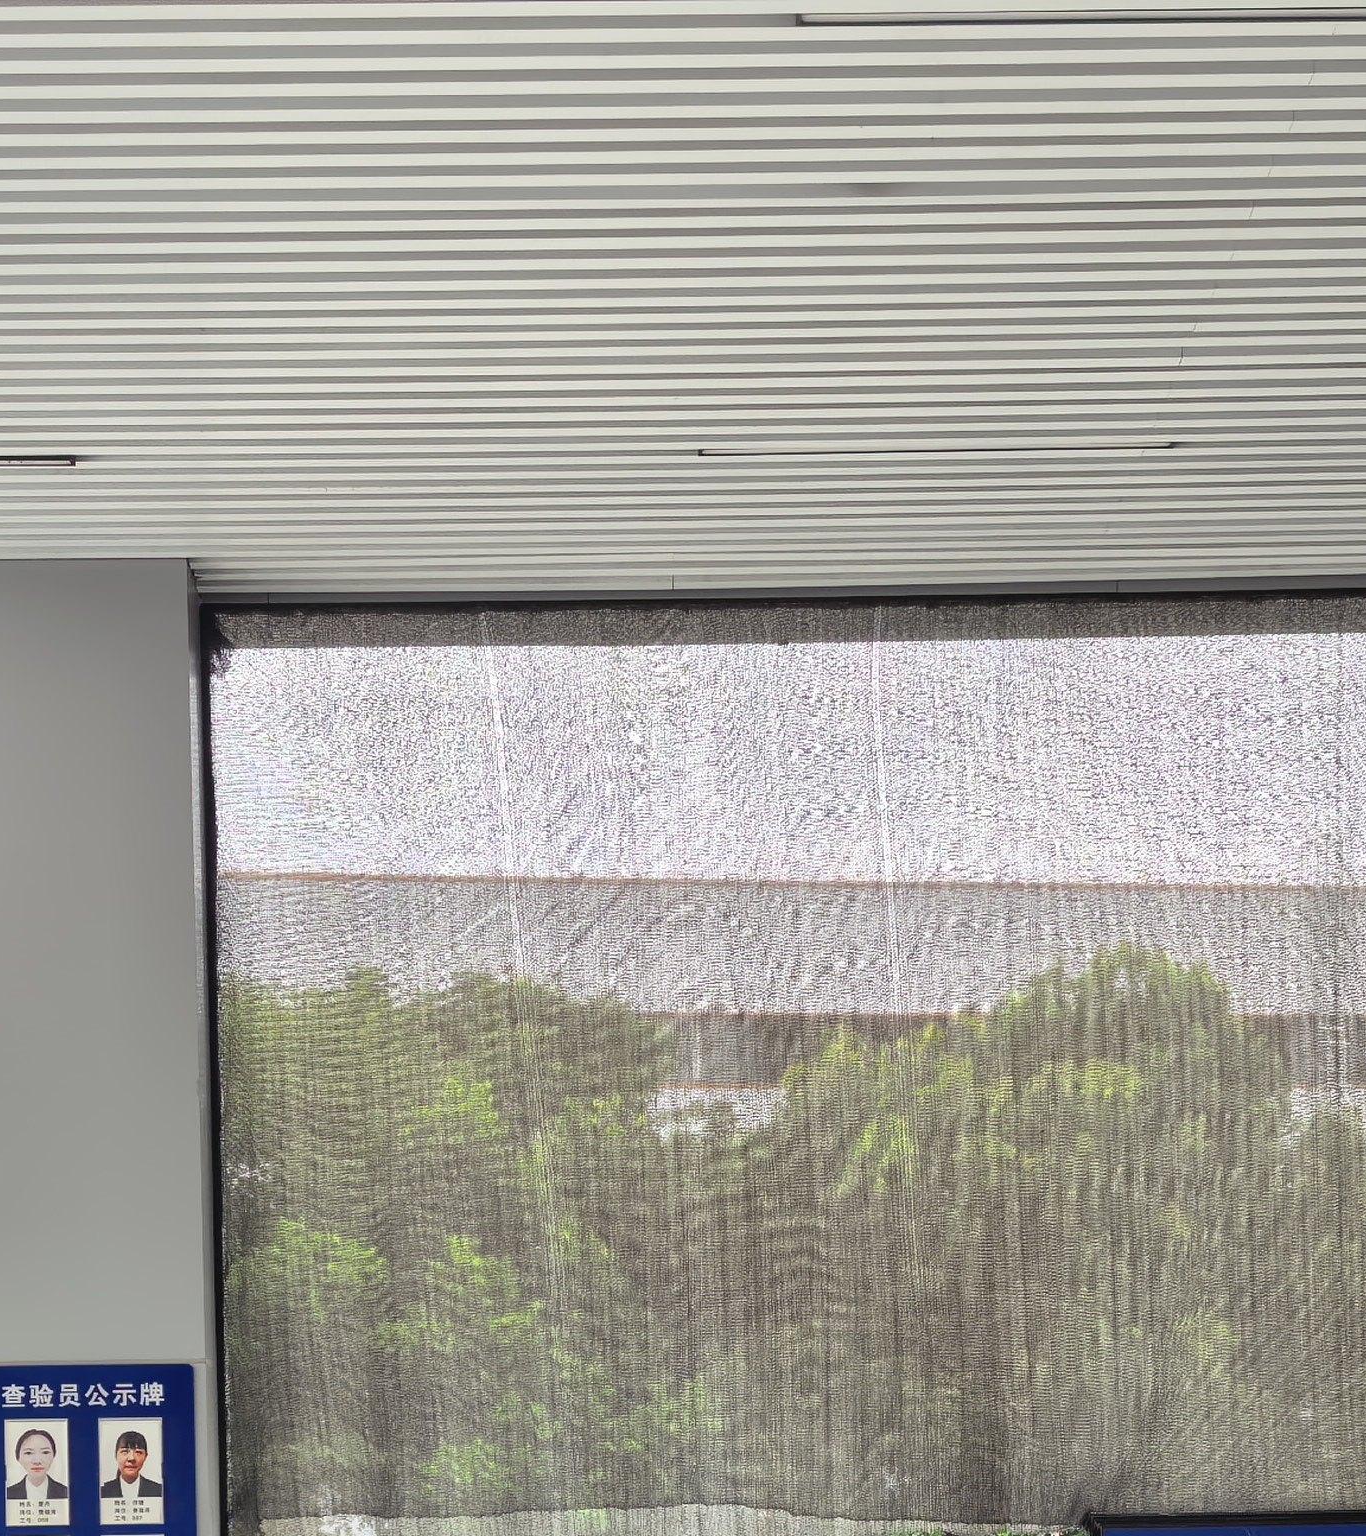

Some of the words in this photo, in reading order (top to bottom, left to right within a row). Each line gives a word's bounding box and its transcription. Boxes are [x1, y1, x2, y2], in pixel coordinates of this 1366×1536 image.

[1, 1381, 165, 1408] 查验员公示牌
